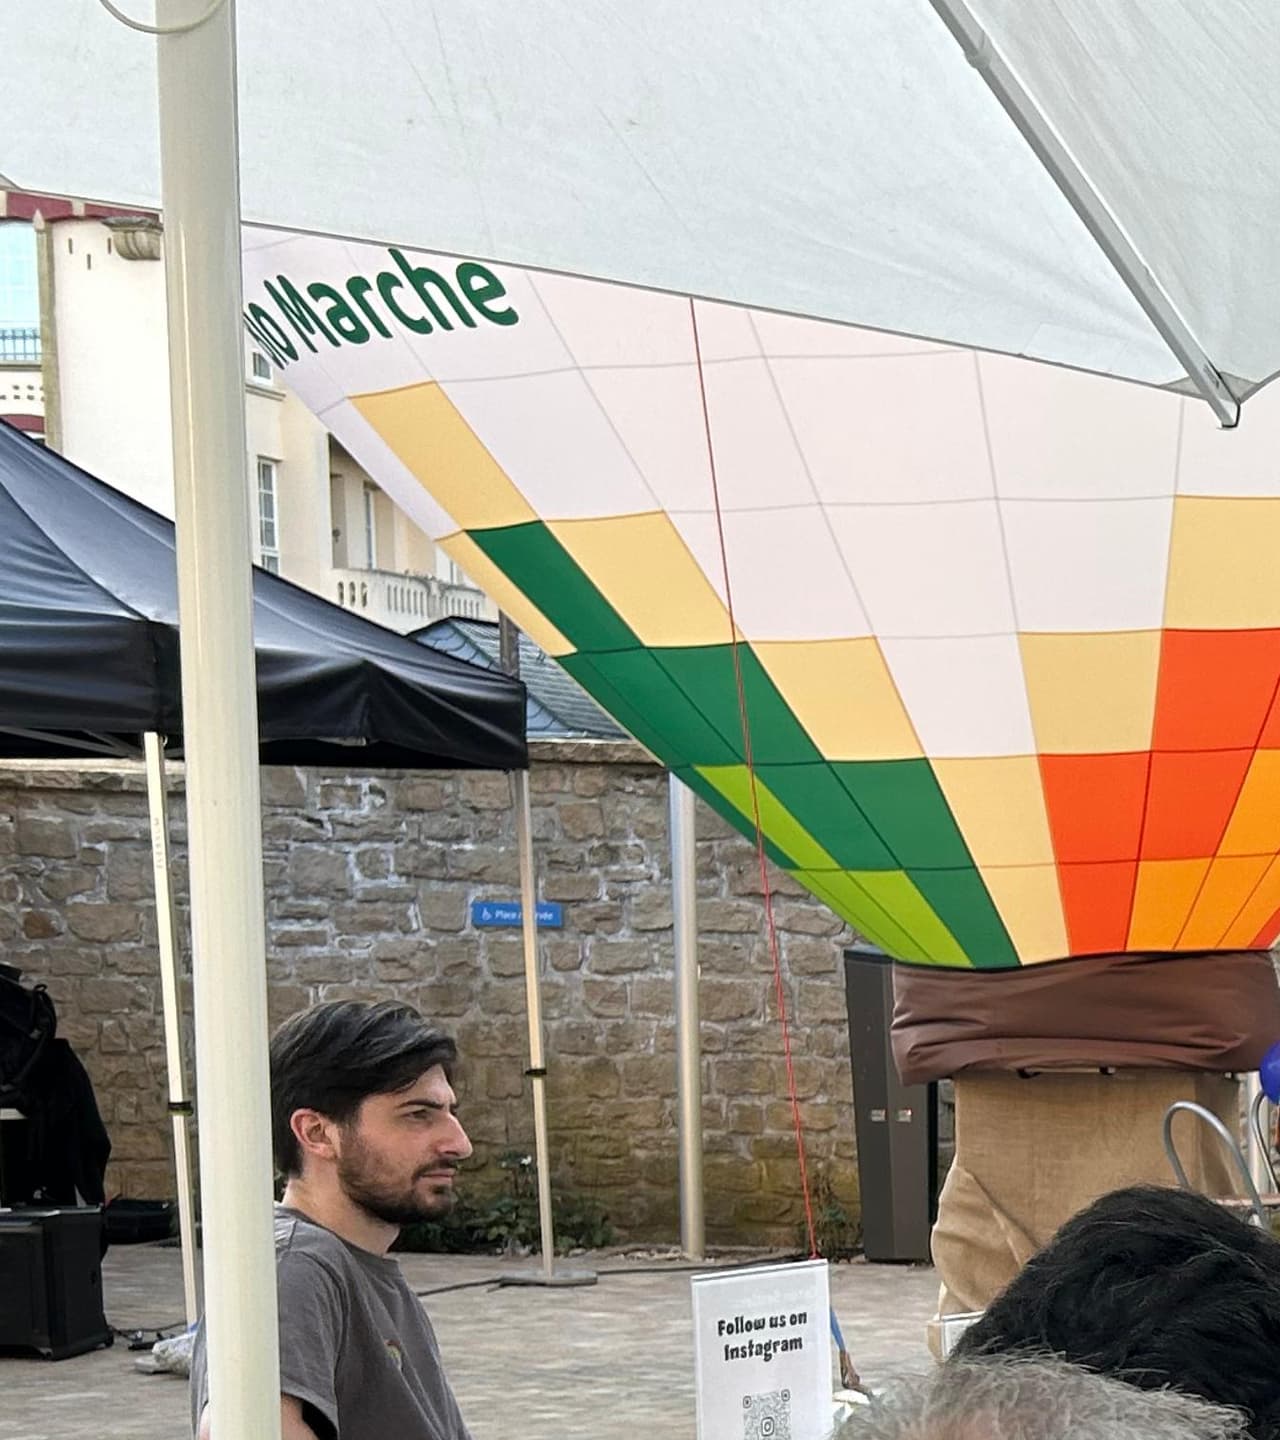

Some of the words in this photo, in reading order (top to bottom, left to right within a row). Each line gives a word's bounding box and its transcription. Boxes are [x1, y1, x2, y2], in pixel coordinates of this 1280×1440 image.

[717, 1317, 766, 1336] Follow
[769, 1315, 786, 1328] us
[790, 1311, 808, 1326] on
[724, 1335, 803, 1362] Instagram
